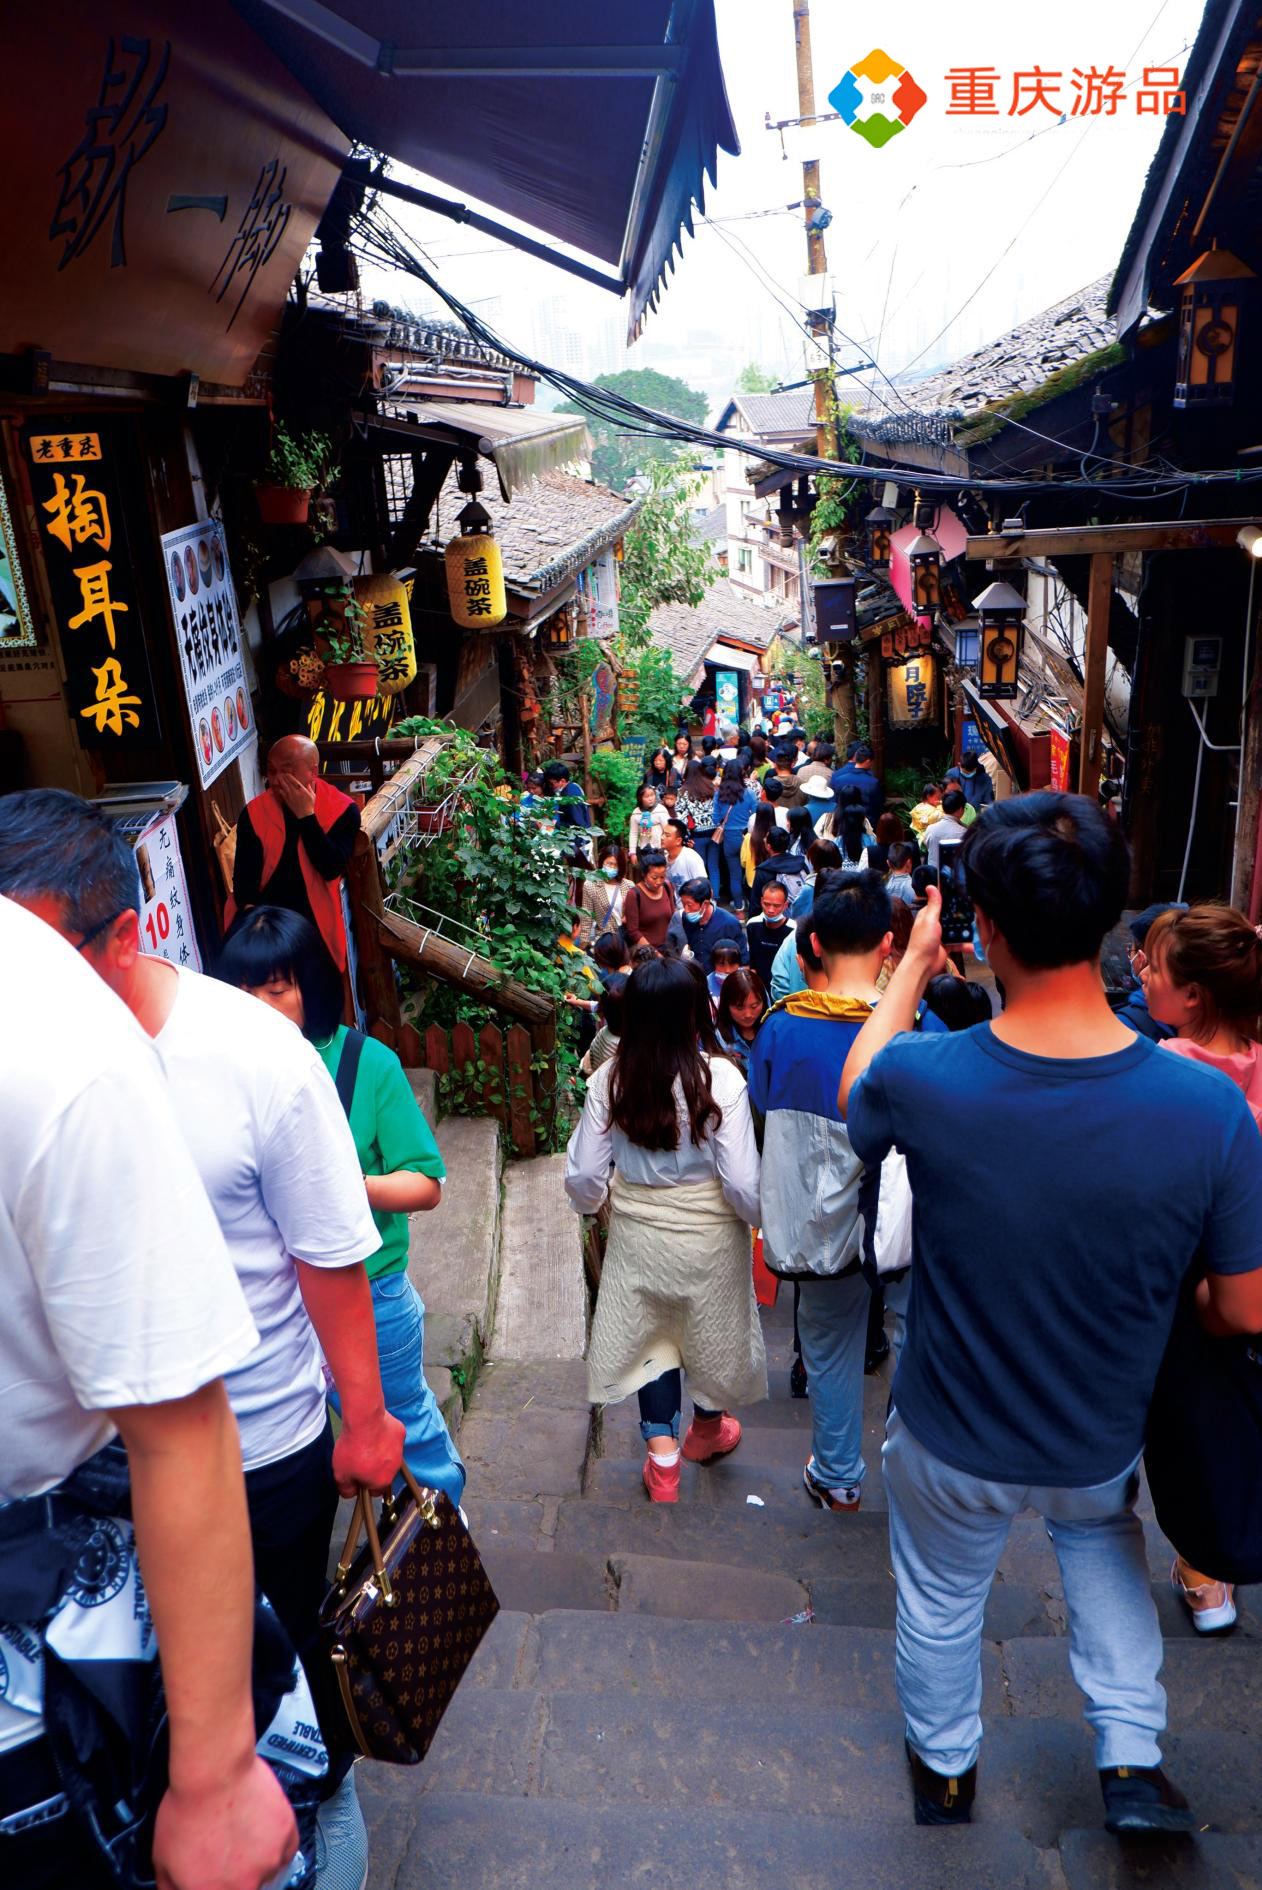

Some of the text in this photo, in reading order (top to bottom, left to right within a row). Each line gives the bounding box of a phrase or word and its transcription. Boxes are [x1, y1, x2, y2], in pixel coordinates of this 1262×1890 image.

[36, 435, 98, 459] 老重庆
[42, 473, 142, 736] 掏耳朵
[464, 557, 492, 616] 盖碗茶
[372, 601, 410, 682] 盖碗茶
[145, 902, 170, 950] 10
